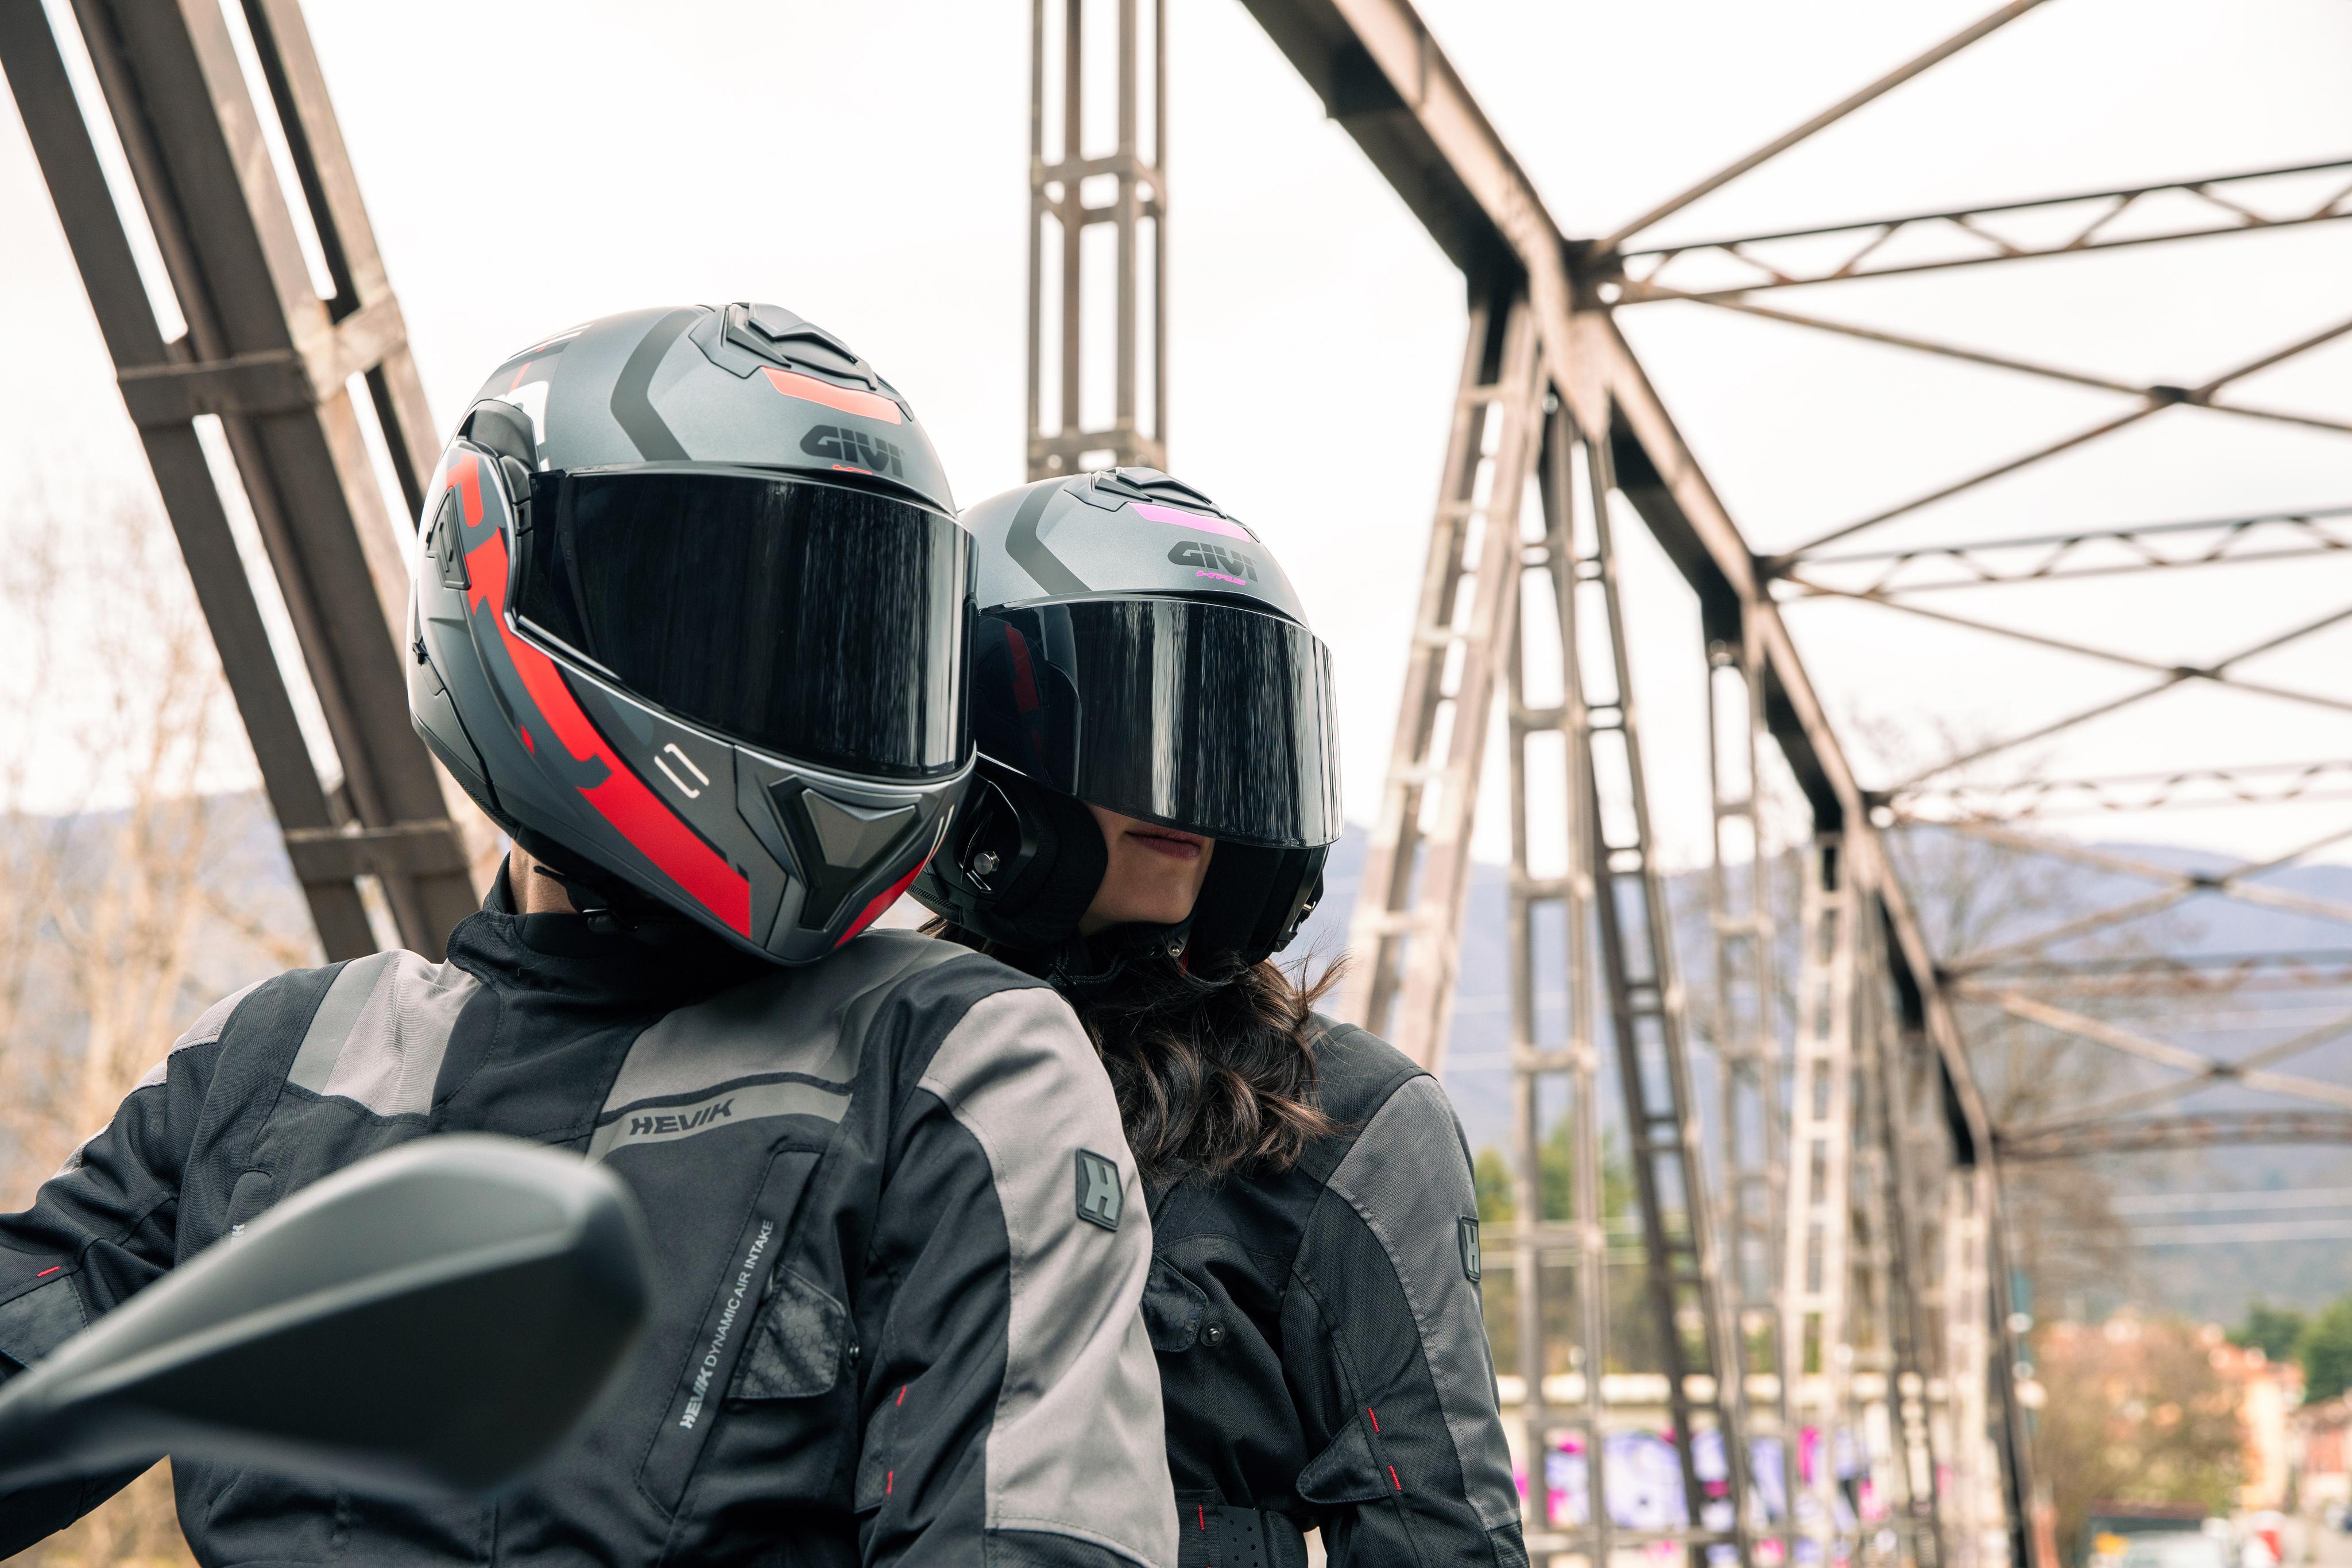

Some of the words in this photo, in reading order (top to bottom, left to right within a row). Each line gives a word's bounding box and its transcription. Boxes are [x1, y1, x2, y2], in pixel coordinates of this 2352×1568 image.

[800, 424, 904, 479] GIVI
[1167, 541, 1258, 583] GIVI
[629, 1098, 735, 1136] HEVIK
[679, 1366, 713, 1429] HEVIK
[704, 1298, 740, 1367] DYNAMIC
[734, 1271, 751, 1298] AIR
[744, 1219, 773, 1269] INTAKE
